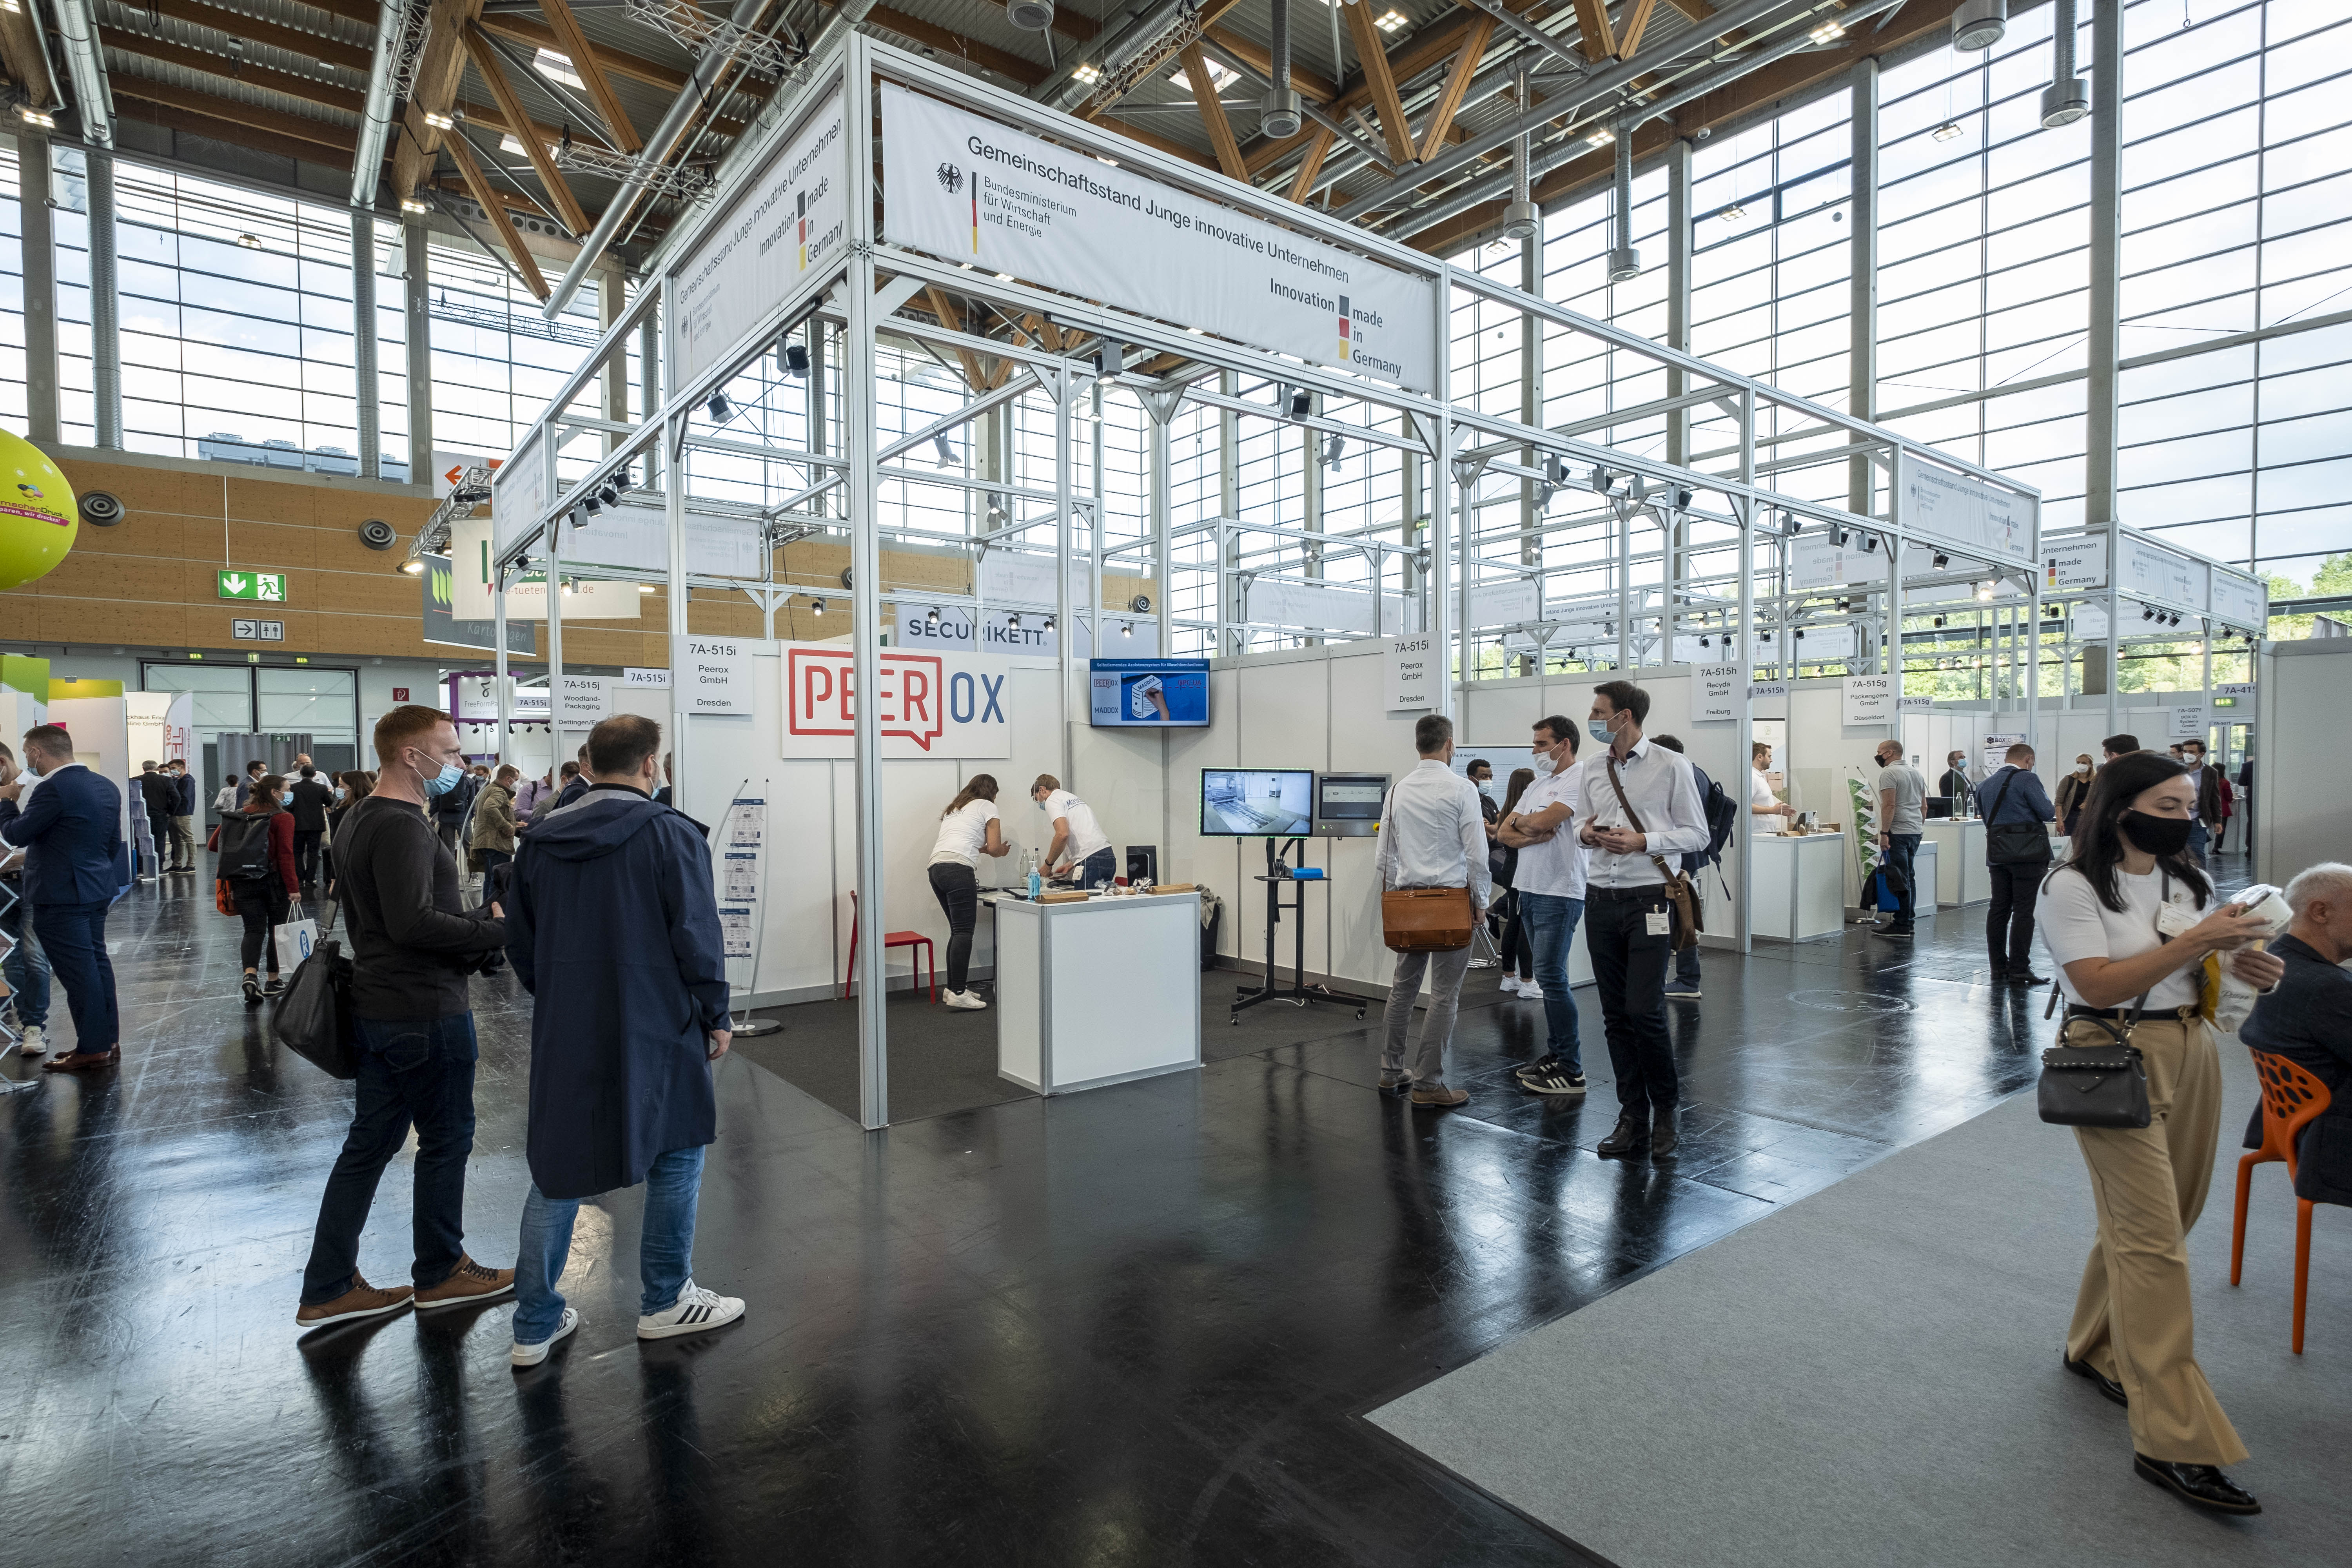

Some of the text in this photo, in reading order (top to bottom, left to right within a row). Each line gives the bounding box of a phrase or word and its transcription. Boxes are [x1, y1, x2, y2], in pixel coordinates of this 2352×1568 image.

[807, 176, 828, 210] made
[984, 176, 1076, 217] Bundesministerium
[680, 119, 840, 304] Gemeinschaftsstand Junge innovative Unternehmen
[968, 136, 1349, 283] Gemeinschaftsstand Junge innovative Unternehmen
[984, 192, 1051, 225] für Wirtschaft
[808, 219, 813, 237] in
[984, 211, 1042, 238] und Energie
[760, 211, 795, 258] Innovation
[808, 220, 843, 263] Germany
[1270, 278, 1334, 312] Innovation
[1353, 307, 1383, 328] made
[1353, 326, 1363, 343] in
[1353, 349, 1402, 379] Germany
[37, 514, 60, 523] drucken!
[2058, 558, 2082, 567] made
[2058, 576, 2096, 586] Germany
[1575, 603, 1599, 612] innovative
[467, 622, 526, 642] Kartogen
[690, 644, 736, 656] 7A-515i
[1395, 639, 1429, 653] 7A-515i
[631, 673, 666, 682] 7A-515i
[699, 665, 729, 673] Peerox
[1402, 672, 1422, 681] GmbH
[1700, 667, 1737, 677] 7A-515h
[564, 681, 600, 690] 7A-515j
[1137, 677, 1156, 690] MADDOX
[1852, 680, 1887, 688] 7A-515g
